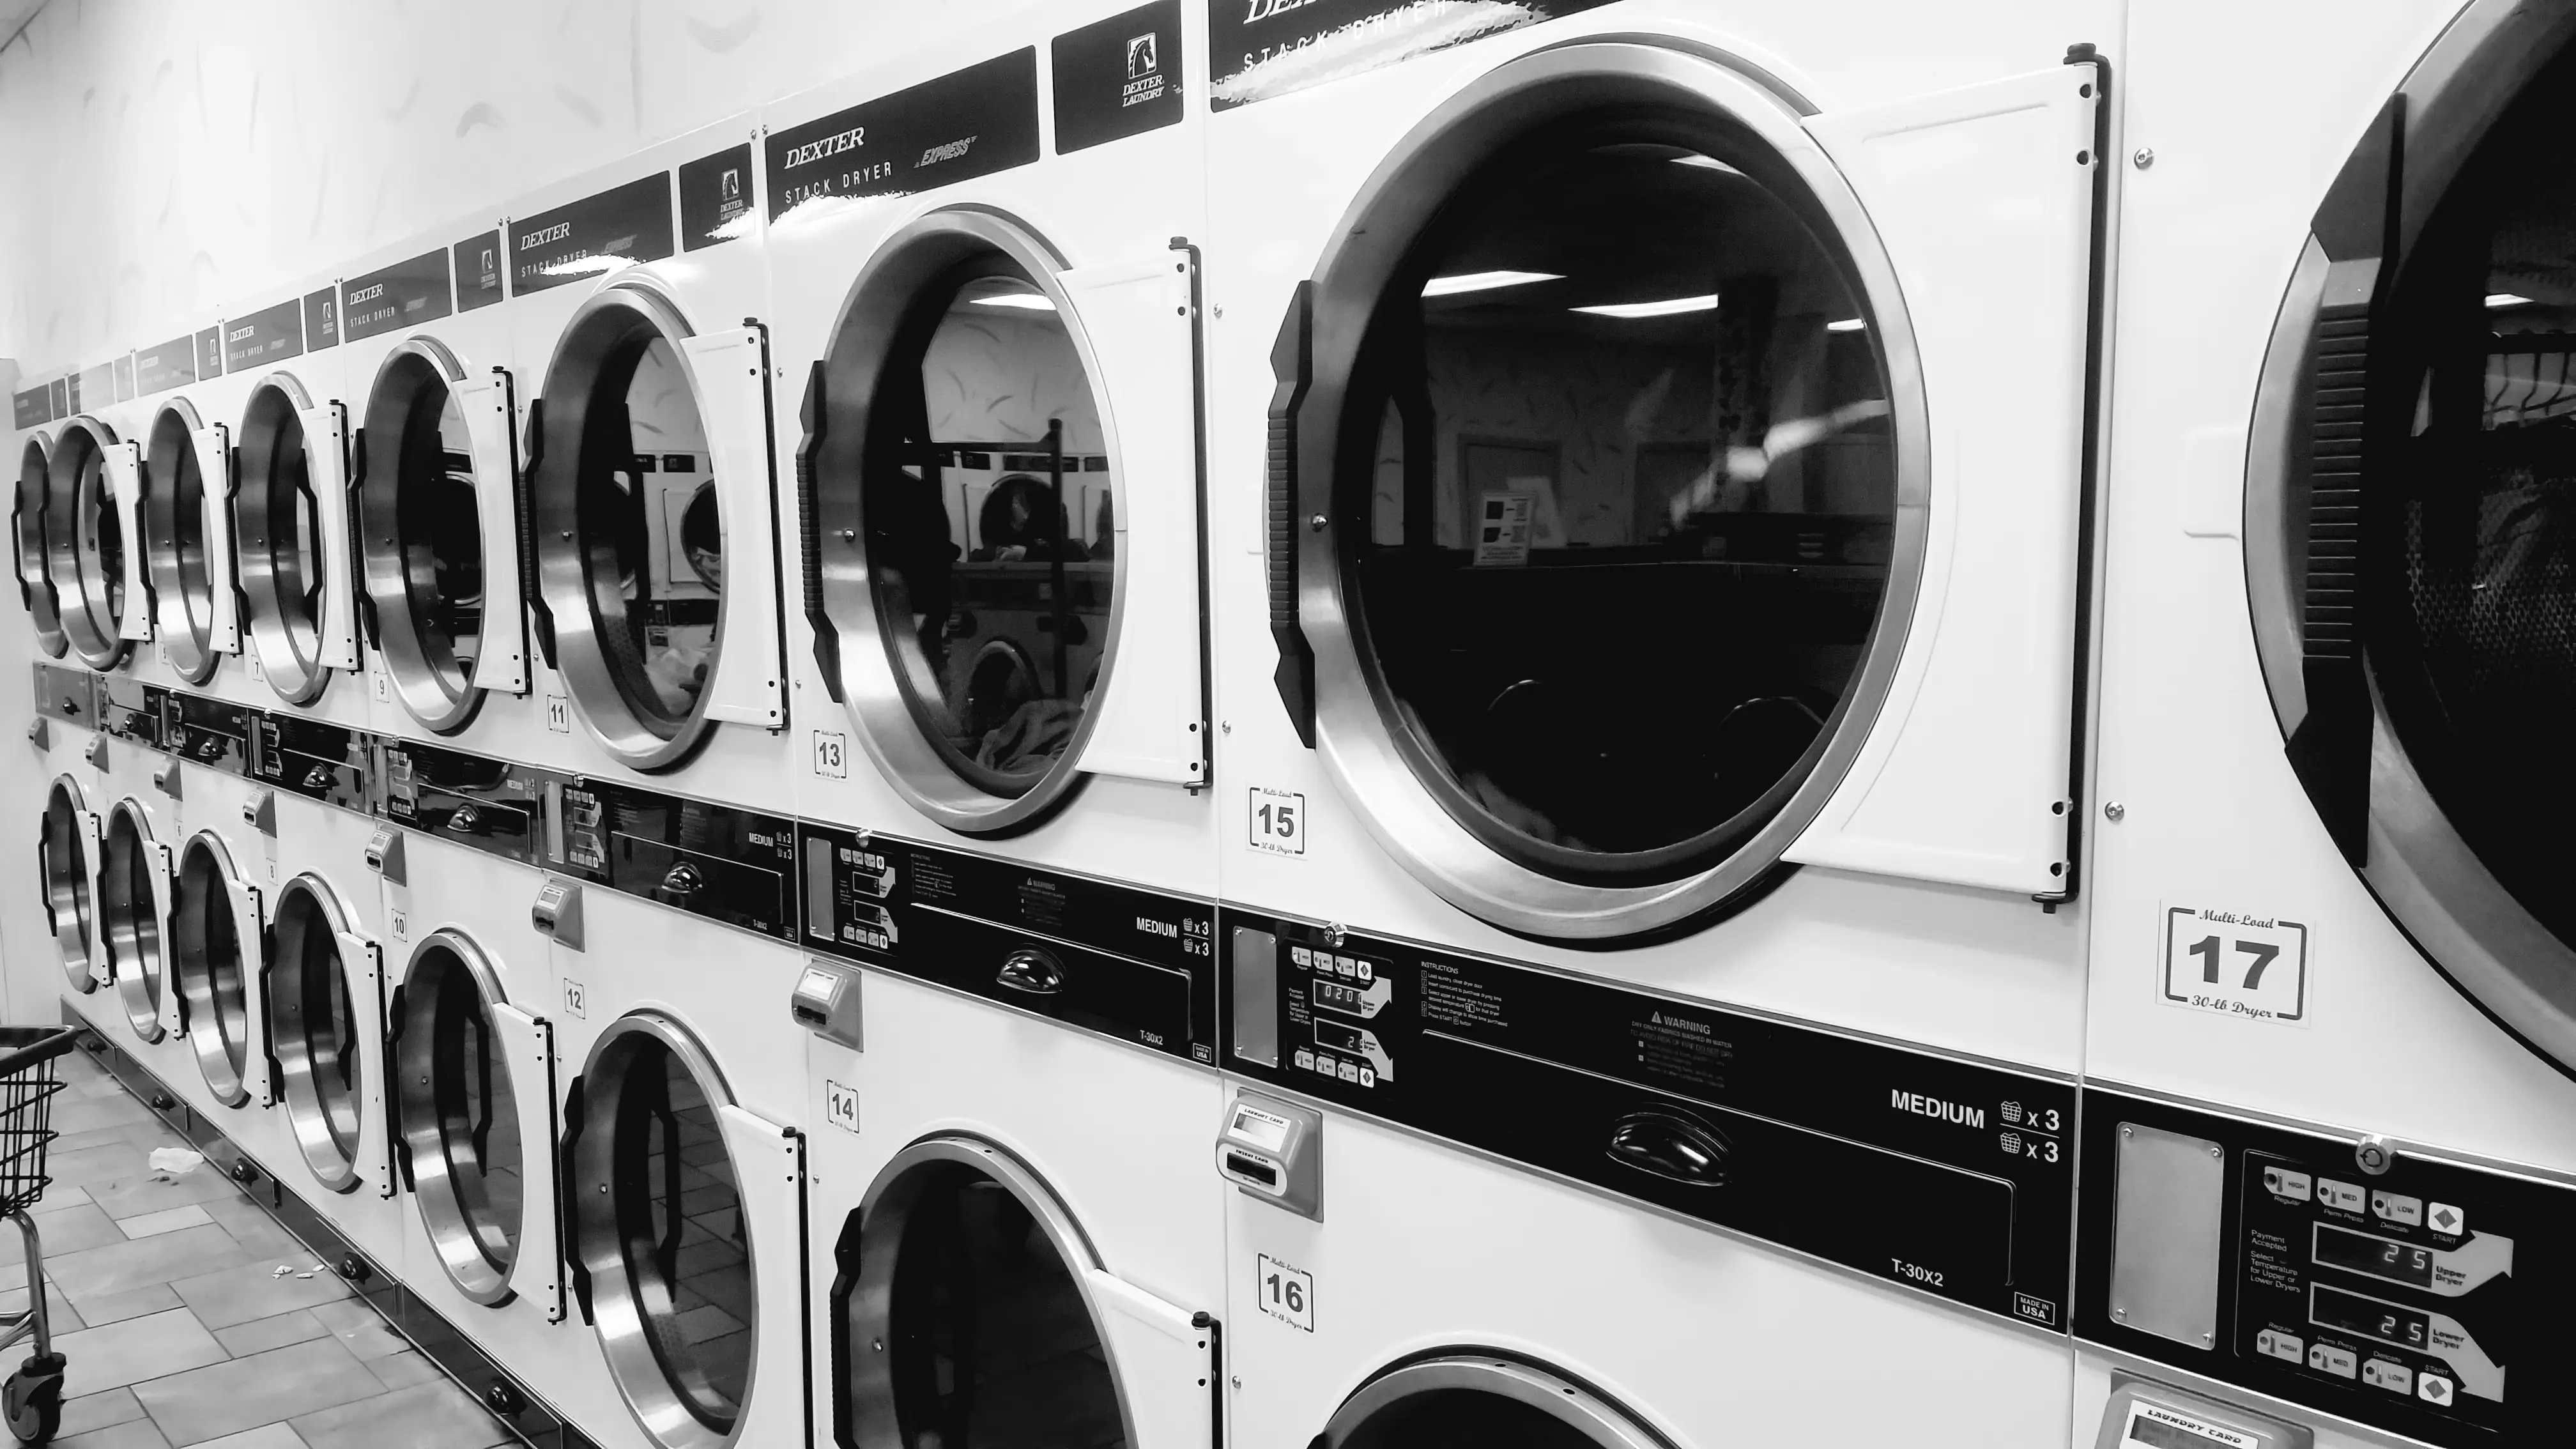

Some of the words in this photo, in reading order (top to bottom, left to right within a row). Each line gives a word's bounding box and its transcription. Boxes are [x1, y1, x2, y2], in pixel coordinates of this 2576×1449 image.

[1244, 31, 1326, 72] STACK
[1123, 75, 1163, 96] DEXTER
[1123, 86, 1165, 107] LAUNDRY
[785, 126, 865, 170] DEXTER
[785, 181, 831, 204] STACK
[843, 162, 893, 188] DRYER
[521, 222, 570, 251] DEXTER
[349, 284, 383, 305] DEXTER
[350, 313, 370, 328] STACK
[374, 306, 395, 321] DRYER
[229, 325, 254, 342] DEXTER
[379, 680, 385, 694] 9
[551, 703, 564, 724] 11
[820, 742, 840, 766] 13
[1259, 804, 1294, 837] 15
[749, 832, 773, 847] MEDIUM
[787, 833, 791, 843] 3
[788, 848, 792, 859] 3
[1276, 845, 1293, 855] Dryer
[394, 917, 404, 934] 10
[2199, 909, 2274, 929] Multi-Load
[1137, 917, 1177, 938] MEDIUM
[1195, 923, 1200, 933] x
[1202, 921, 1209, 935] 3
[1195, 944, 1200, 954] x
[1202, 942, 1209, 956] 3
[1421, 961, 1459, 974] INSTRUCTIONS
[2189, 935, 2279, 990] 17
[568, 988, 581, 1009] 12
[2192, 995, 2227, 1010] 30-lb
[2232, 1001, 2273, 1018] Dryer
[1664, 1016, 1710, 1035] WARNING
[1140, 1029, 1163, 1045] T-30X2
[832, 1093, 853, 1121] 14
[1892, 1089, 1984, 1129] MEDIUM
[2027, 1111, 2039, 1128] x
[2045, 1109, 2059, 1130] 3
[1236, 1149, 1254, 1158] INSERT
[2027, 1143, 2037, 1159] x
[2044, 1141, 2058, 1162] 3
[2288, 1181, 2305, 1190] HIGH
[2274, 1195, 2301, 1206] Regular
[2342, 1192, 2358, 1201] MED
[2397, 1205, 2414, 1215] LOW
[2251, 1229, 2285, 1243] Payment
[2432, 1233, 2457, 1245] START
[2252, 1238, 2287, 1252] Accepted
[2251, 1250, 2274, 1262] Select
[1892, 1258, 1943, 1287] T-30X2
[2251, 1258, 2297, 1276] Temperature
[2262, 1269, 2285, 1280] Upper
[2436, 1265, 2466, 1279] Upper
[2251, 1275, 2273, 1285] Lower
[2275, 1280, 2300, 1293] Dryers
[2435, 1274, 2464, 1286] Dryer
[1268, 1273, 1303, 1312] 16
[2020, 1296, 2040, 1308] MADE
[2041, 1302, 2049, 1311] IN
[2022, 1305, 2046, 1319] USA
[1286, 1317, 1302, 1329] Dryer
[2269, 1322, 2294, 1333] Regular
[2433, 1328, 2465, 1342] Lower
[2433, 1336, 2460, 1349] Dryer
[2280, 1343, 2297, 1353] HIGH
[2334, 1357, 2348, 1367] MED
[2388, 1372, 2405, 1383] LOW
[2425, 1364, 2450, 1376] START
[2147, 1409, 2205, 1432] LAUNDRY
[2209, 1429, 2241, 1445] CARD
